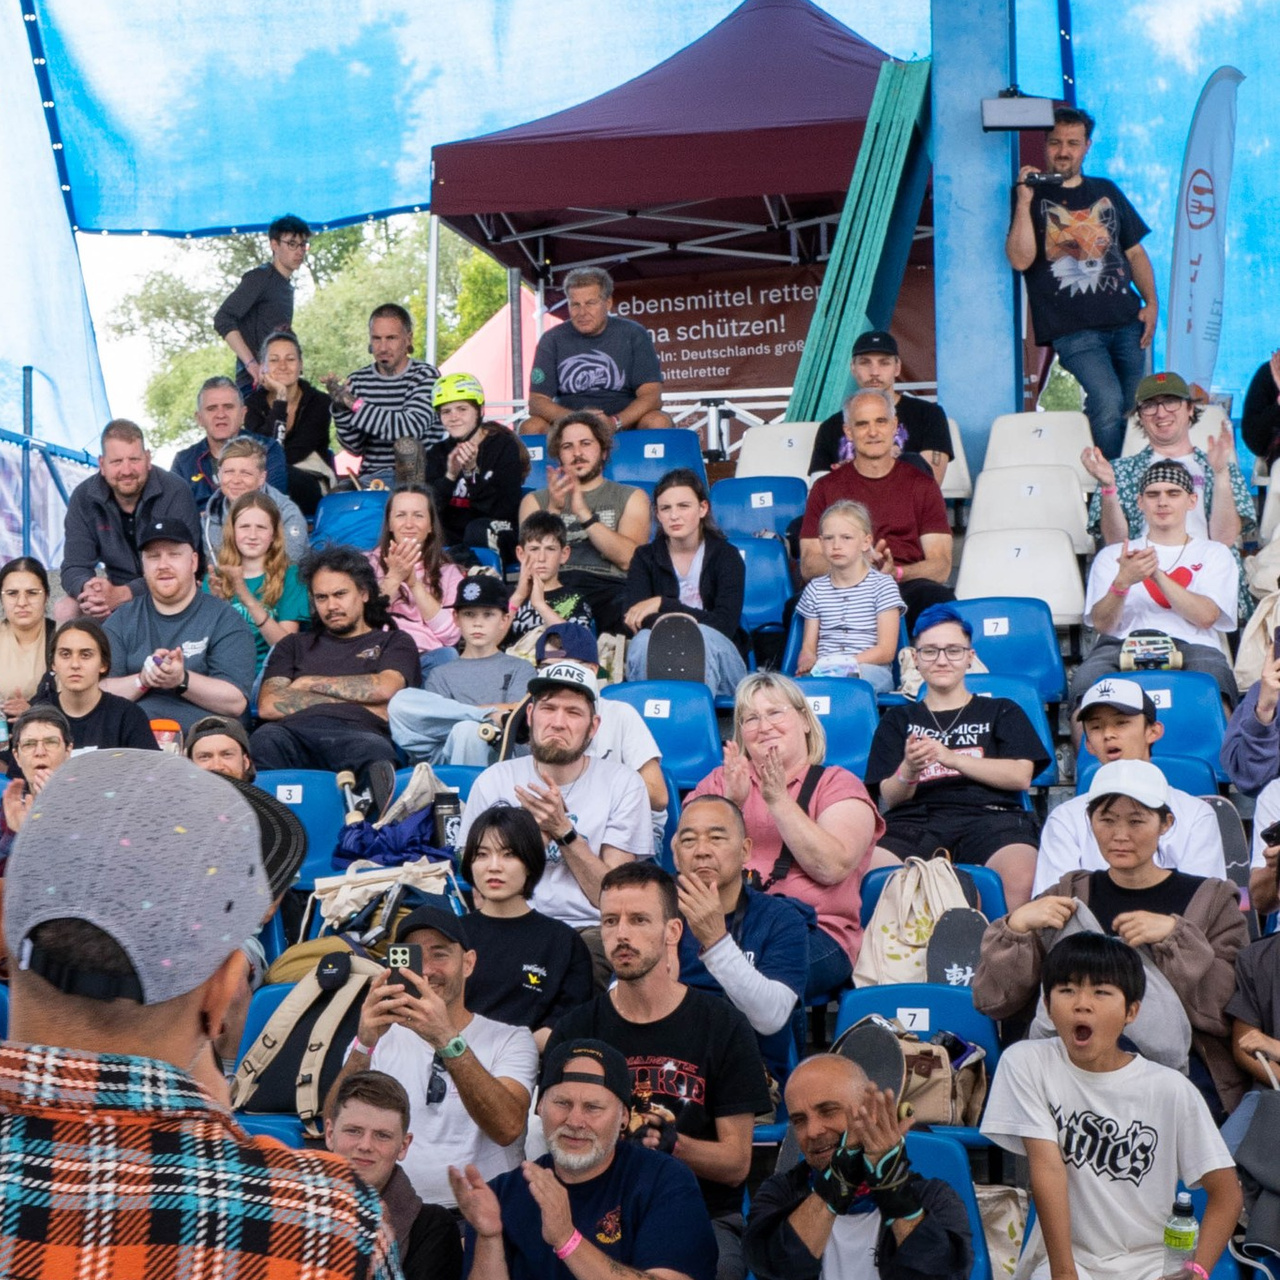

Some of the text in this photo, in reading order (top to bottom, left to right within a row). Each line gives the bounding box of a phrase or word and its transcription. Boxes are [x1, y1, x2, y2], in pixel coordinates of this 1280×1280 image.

[676, 314, 786, 341] schützen!
[680, 341, 771, 361] Deutschlands
[787, 438, 794, 448] 5
[651, 447, 657, 456] 4
[1027, 485, 1034, 495] 7
[759, 495, 766, 506] 5
[1014, 547, 1022, 558] 7
[992, 621, 999, 632] 7
[546, 666, 585, 684] VANS
[1153, 694, 1161, 706] 8
[654, 704, 661, 715] 5
[813, 701, 820, 711] 6
[950, 722, 990, 735] MICH
[955, 734, 978, 745] AN
[286, 788, 293, 800] 3
[908, 1013, 917, 1027] 7
